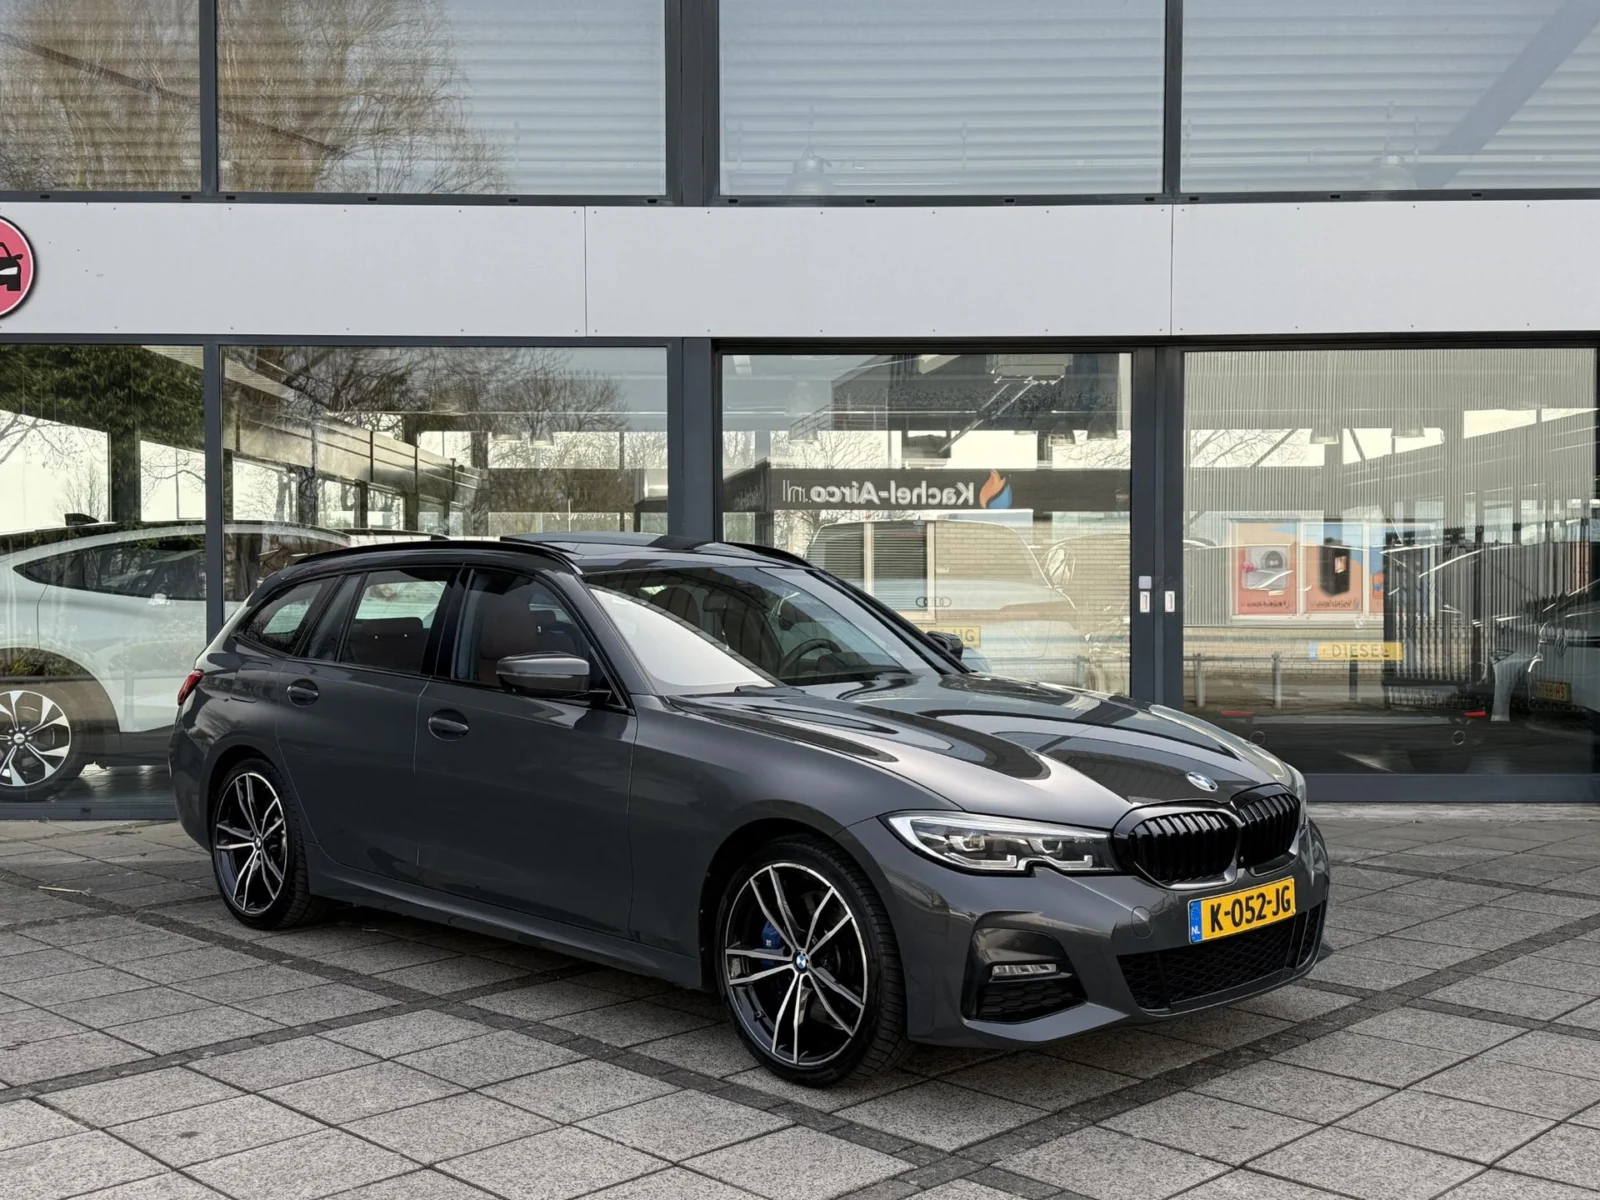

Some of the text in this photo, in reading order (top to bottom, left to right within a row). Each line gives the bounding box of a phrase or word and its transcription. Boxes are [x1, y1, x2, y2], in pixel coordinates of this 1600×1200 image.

[1332, 644, 1390, 658] DIESEL
[1191, 885, 1291, 935] NL K-052-JG
